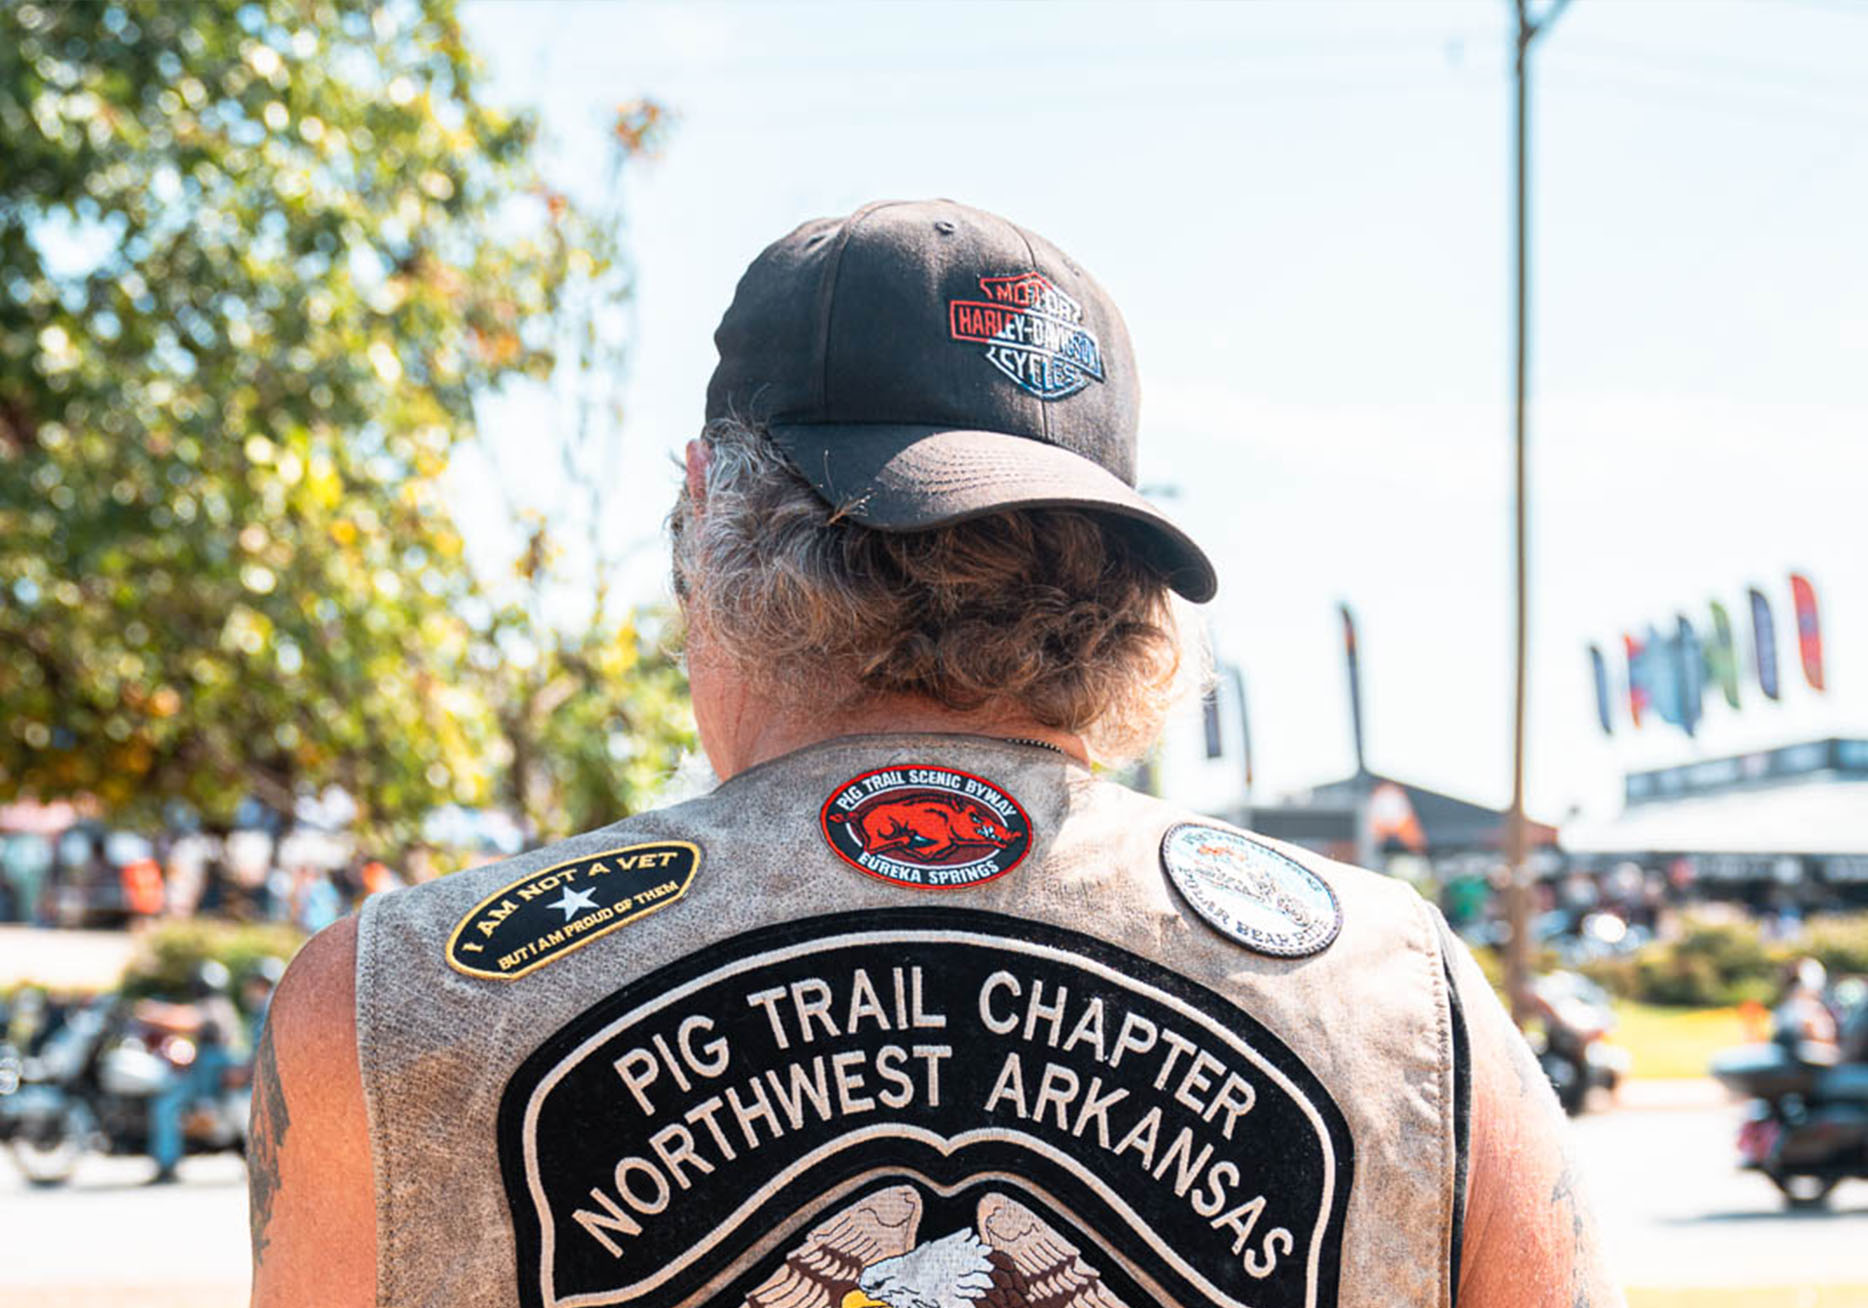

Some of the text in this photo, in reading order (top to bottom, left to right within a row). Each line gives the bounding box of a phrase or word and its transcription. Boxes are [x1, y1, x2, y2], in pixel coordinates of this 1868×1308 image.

[994, 280, 1072, 322] MOTOR
[958, 306, 1095, 367] HARLEY-DAVIDSON
[1000, 349, 1076, 389] CYCLES
[836, 769, 1017, 817] PIG TRAIL SCENIC BYWAY
[857, 852, 1000, 885] EUREKA SPRINGS
[463, 851, 678, 953] I AM NOT A VET
[498, 946, 529, 971] BUT
[539, 931, 566, 954] AM
[565, 908, 614, 938] PROUD
[615, 898, 633, 915] OF
[633, 880, 679, 905] THEM
[612, 966, 1257, 1140] PIG TRAIL CHAPTER
[572, 1044, 1294, 1279] NORTHWEST ARKANSAS
